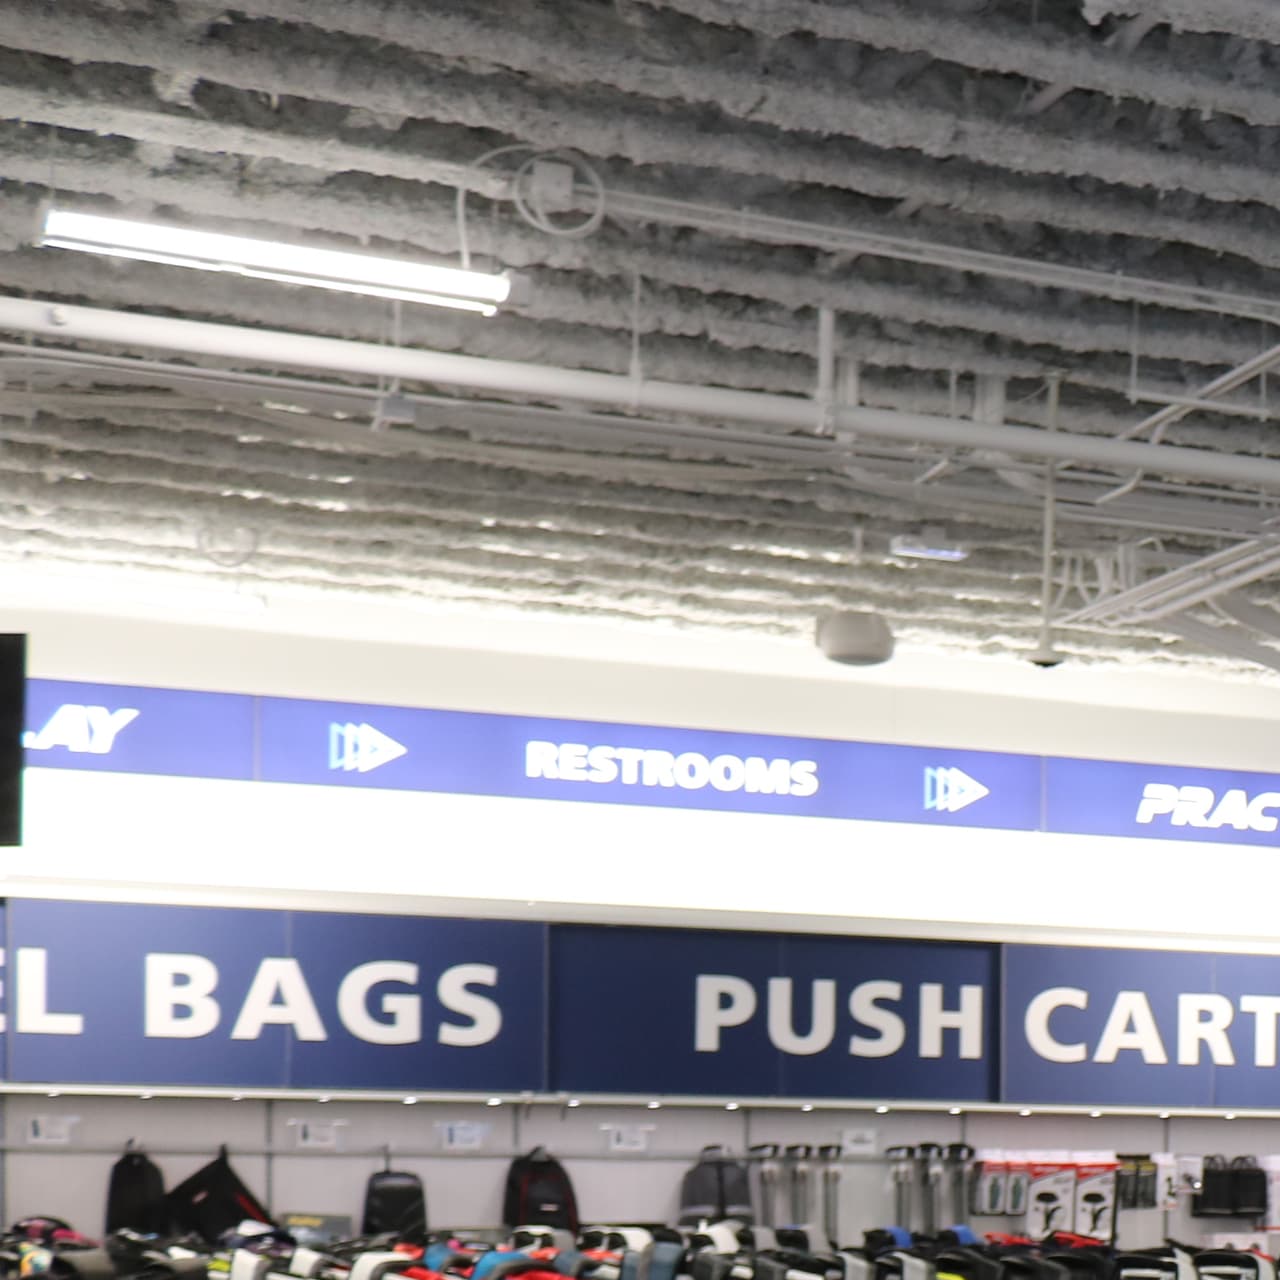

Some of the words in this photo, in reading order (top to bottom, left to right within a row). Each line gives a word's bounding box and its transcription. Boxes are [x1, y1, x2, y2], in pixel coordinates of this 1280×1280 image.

[24, 703, 140, 754] AY
[526, 741, 819, 797] RESTROOMS
[0, 946, 83, 1034] L
[144, 953, 502, 1047] BAGS
[695, 974, 983, 1061] PUSH
